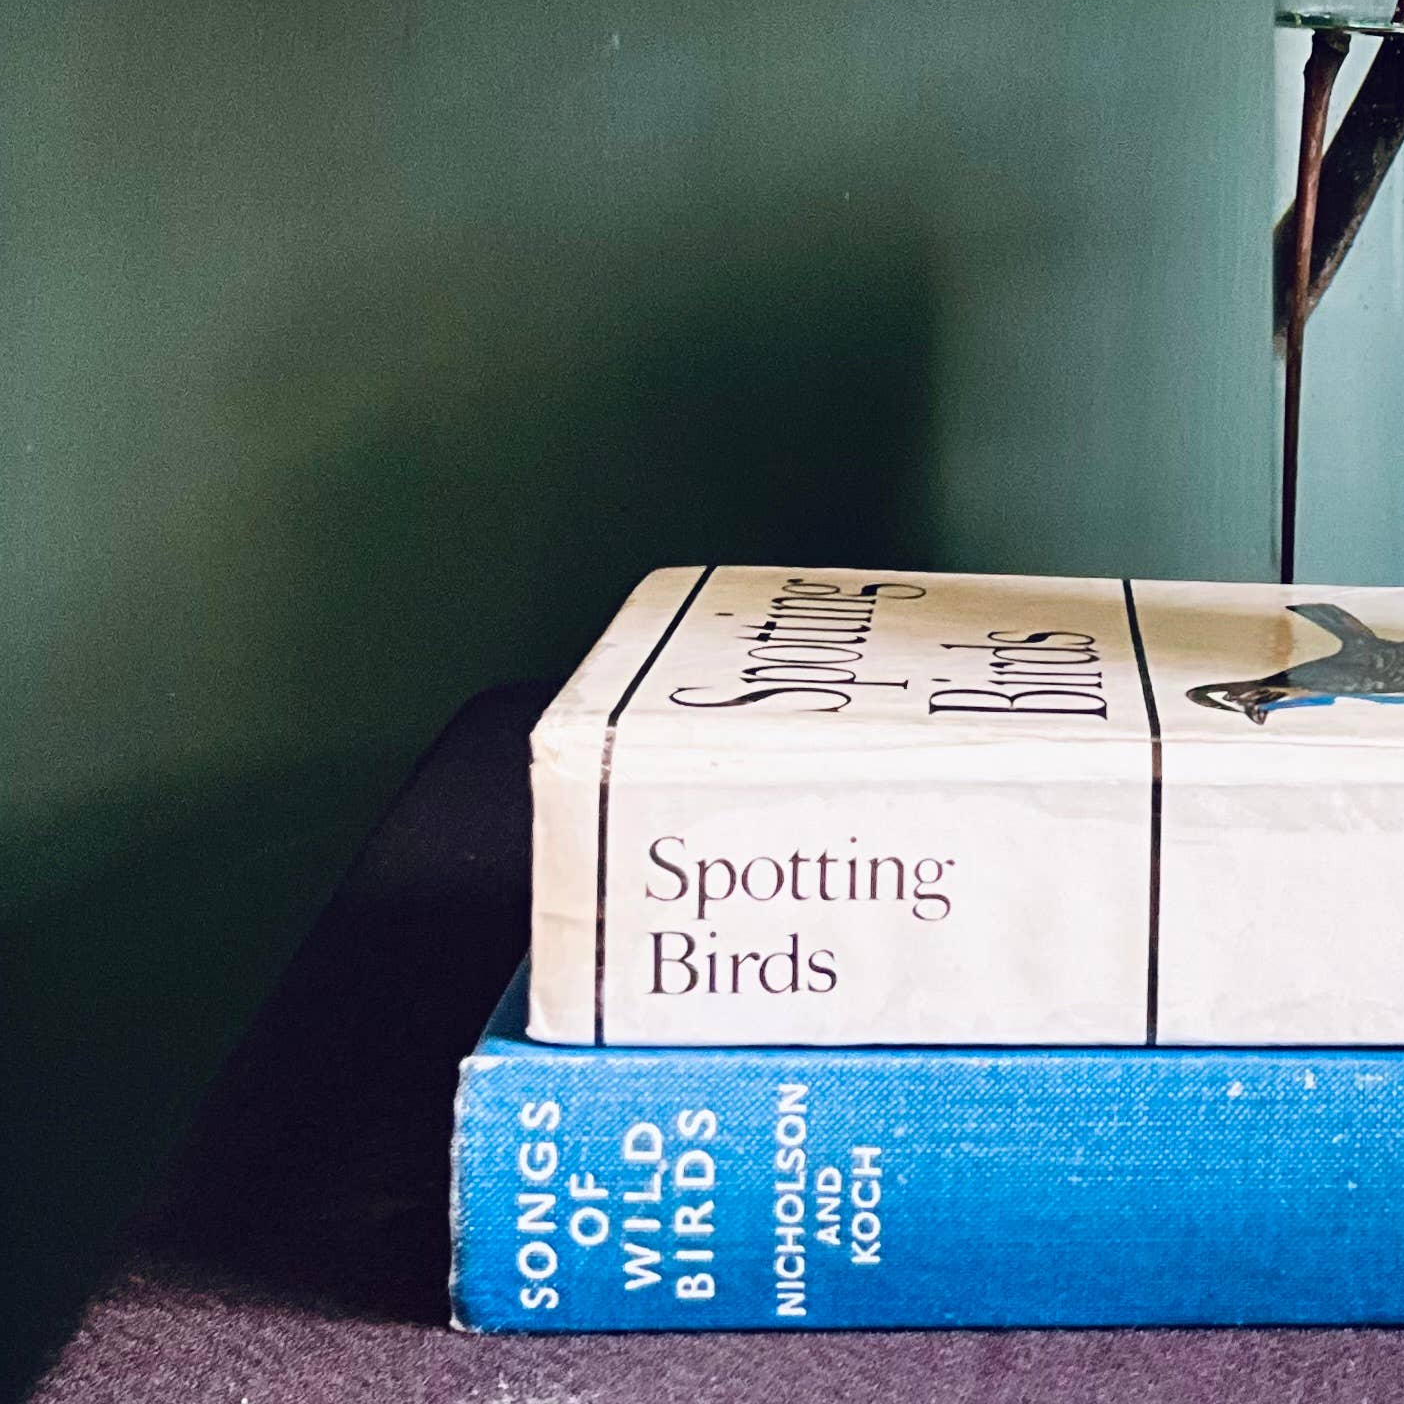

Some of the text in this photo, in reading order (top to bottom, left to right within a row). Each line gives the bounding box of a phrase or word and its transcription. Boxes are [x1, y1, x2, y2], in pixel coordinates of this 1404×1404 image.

[669, 578, 926, 712] Spotting
[929, 630, 1107, 720] Birds
[645, 836, 955, 921] Spotting
[649, 931, 838, 995] Birds
[516, 1099, 561, 1309] SONGS
[569, 1171, 610, 1246] OF
[623, 1122, 664, 1290] WILD
[674, 1108, 717, 1299] BIRDS
[776, 1083, 809, 1316] NICHOLSON
[815, 1167, 842, 1245] AND
[851, 1146, 882, 1264] KOCH
